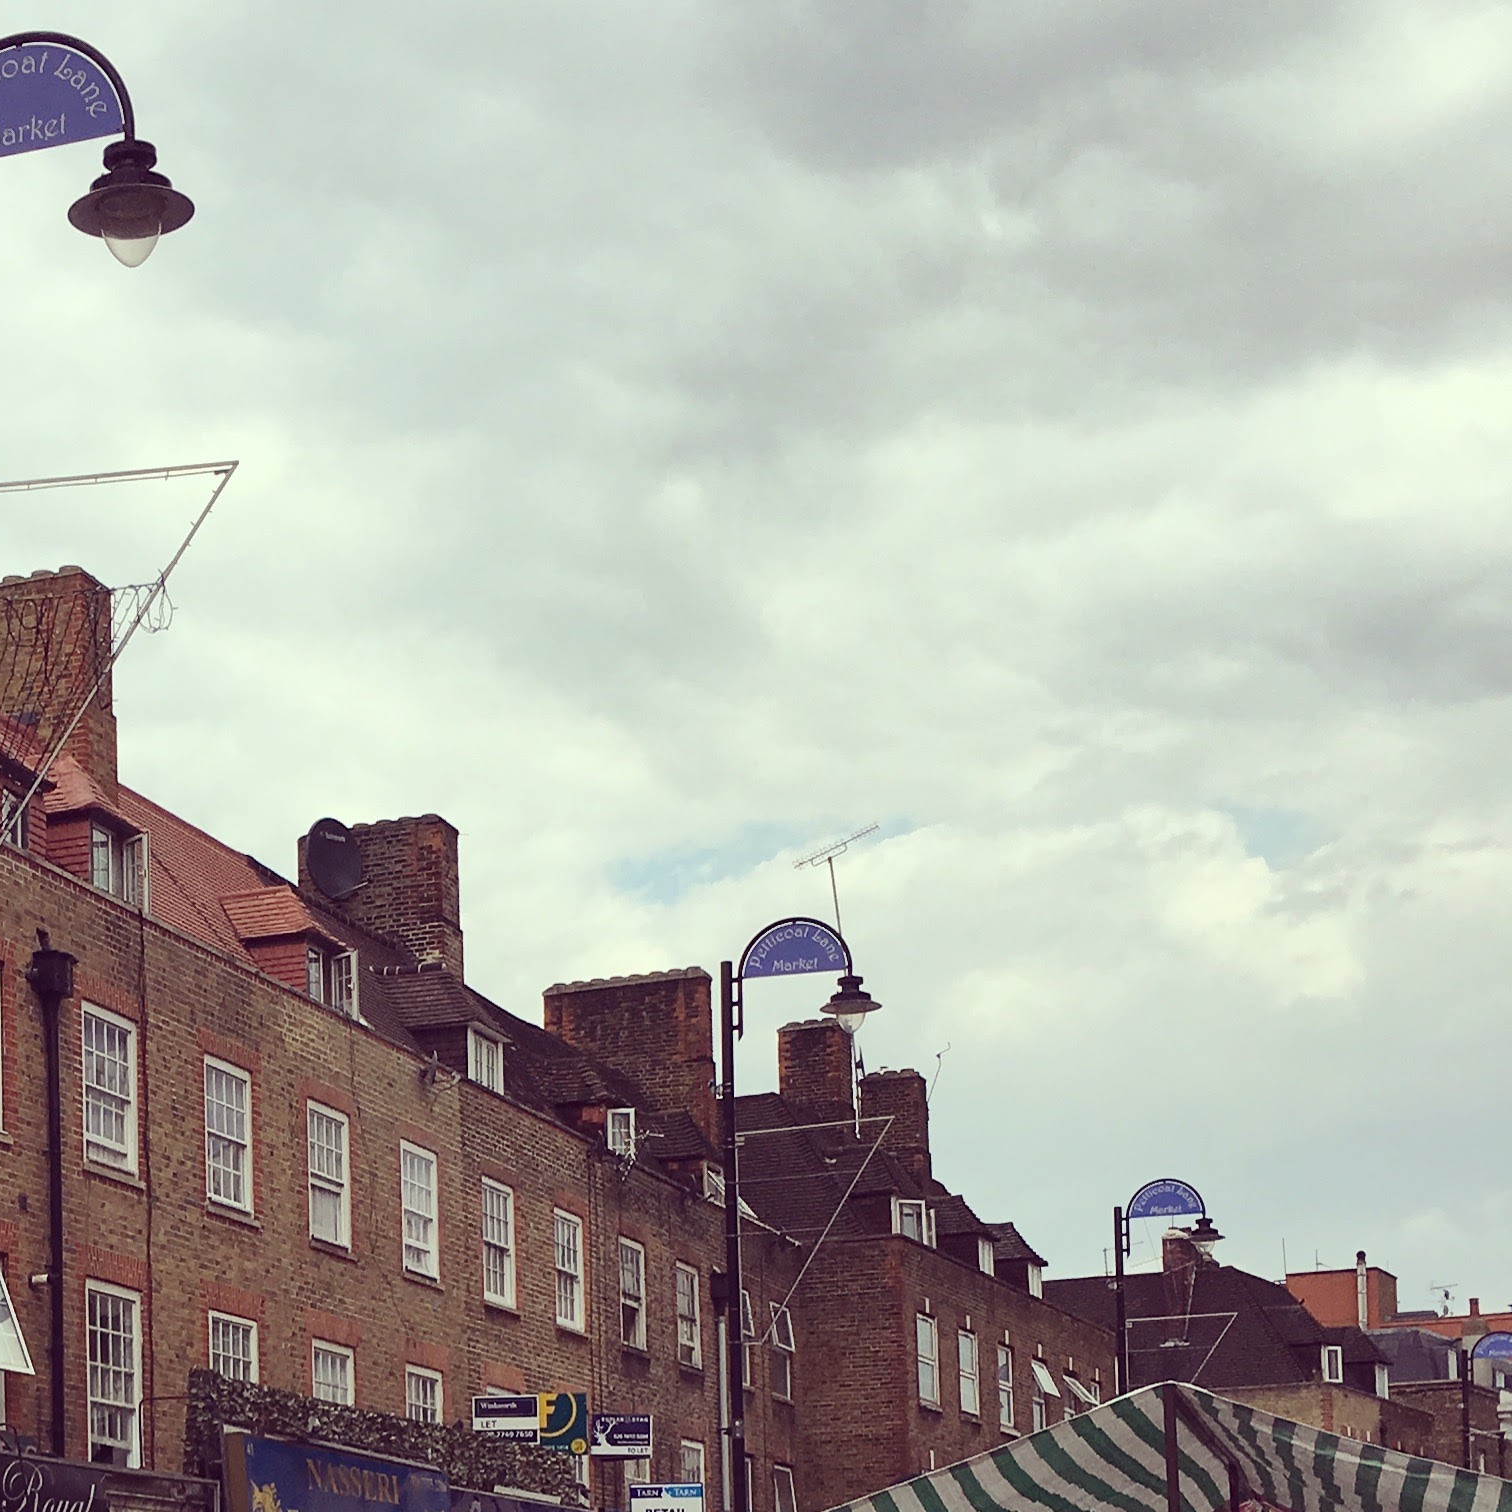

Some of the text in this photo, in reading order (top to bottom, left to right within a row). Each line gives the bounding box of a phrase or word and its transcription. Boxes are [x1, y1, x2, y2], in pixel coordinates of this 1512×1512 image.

[54, 53, 108, 118] Lane
[748, 926, 839, 970] Petticoat Lane
[772, 957, 818, 973] Market
[480, 1420, 497, 1429] LET
[246, 1442, 255, 1457] 41
[305, 1458, 401, 1506] NASSERI
